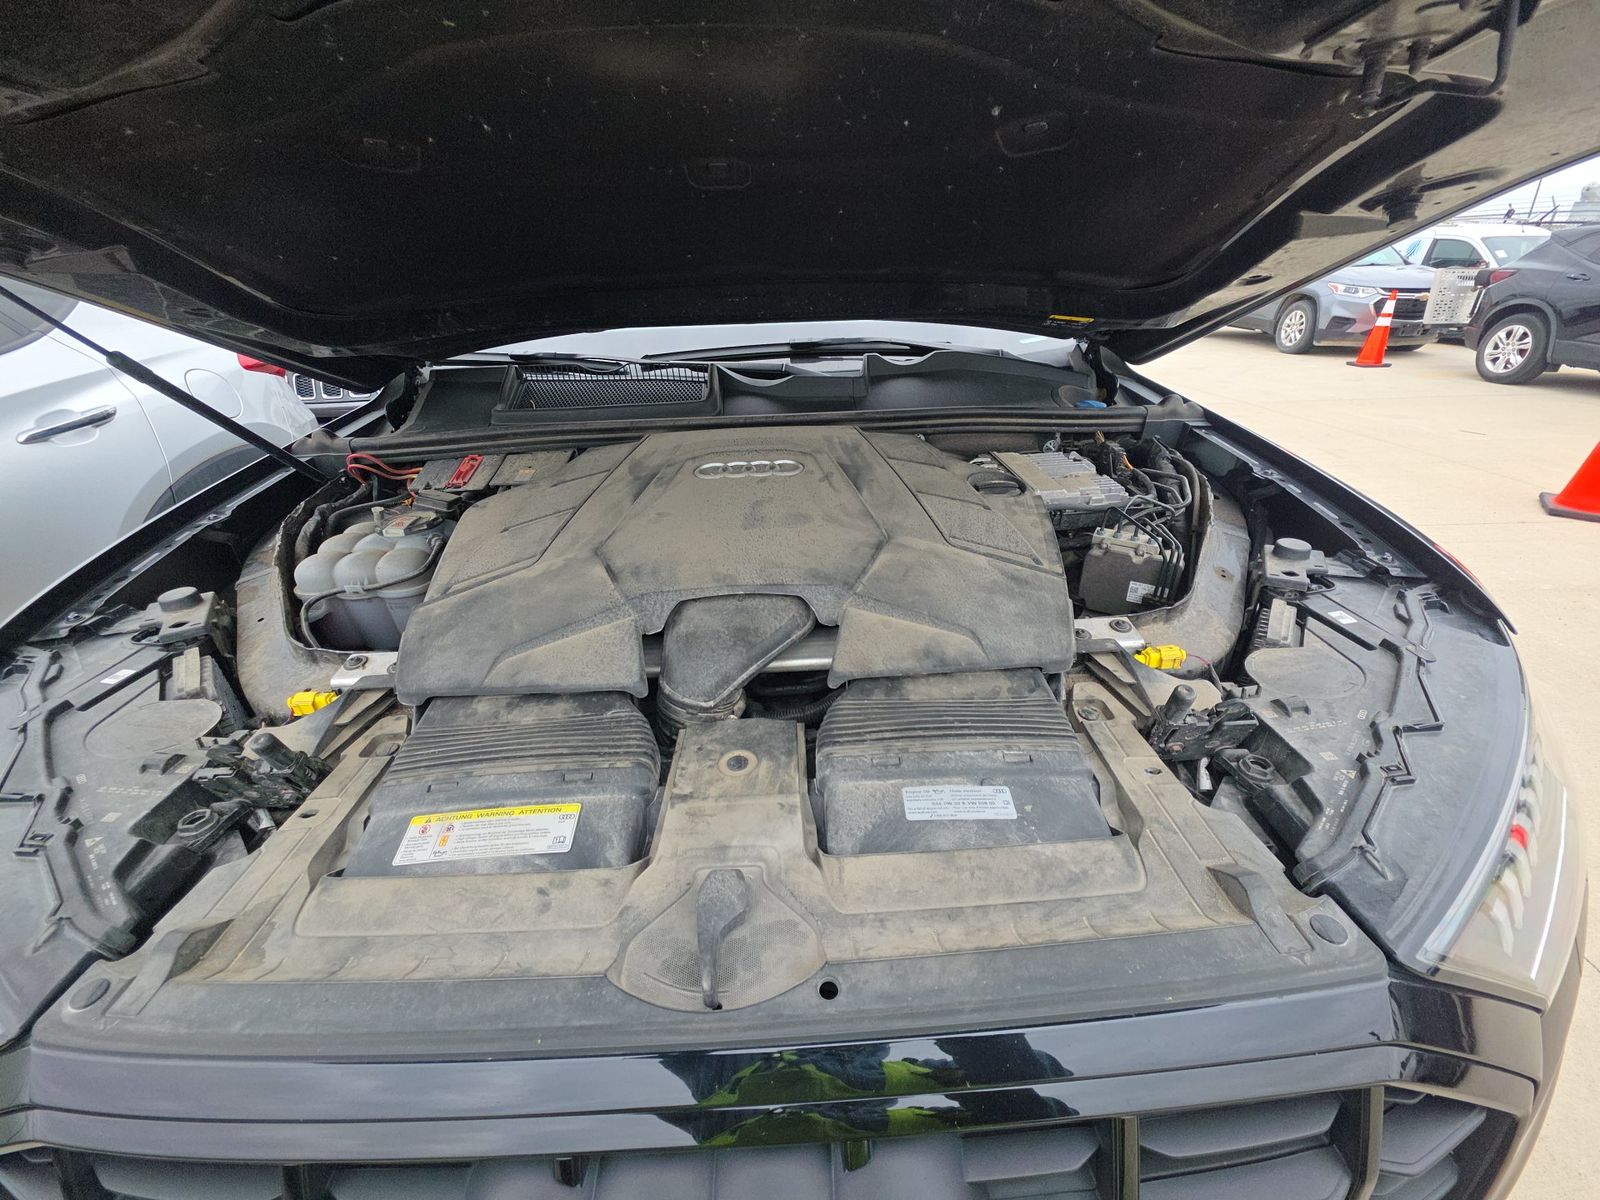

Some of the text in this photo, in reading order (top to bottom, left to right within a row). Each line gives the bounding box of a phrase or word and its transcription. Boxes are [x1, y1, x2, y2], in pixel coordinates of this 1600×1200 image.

[435, 806, 562, 822] ACHTUNG WARNING ATTENTION
